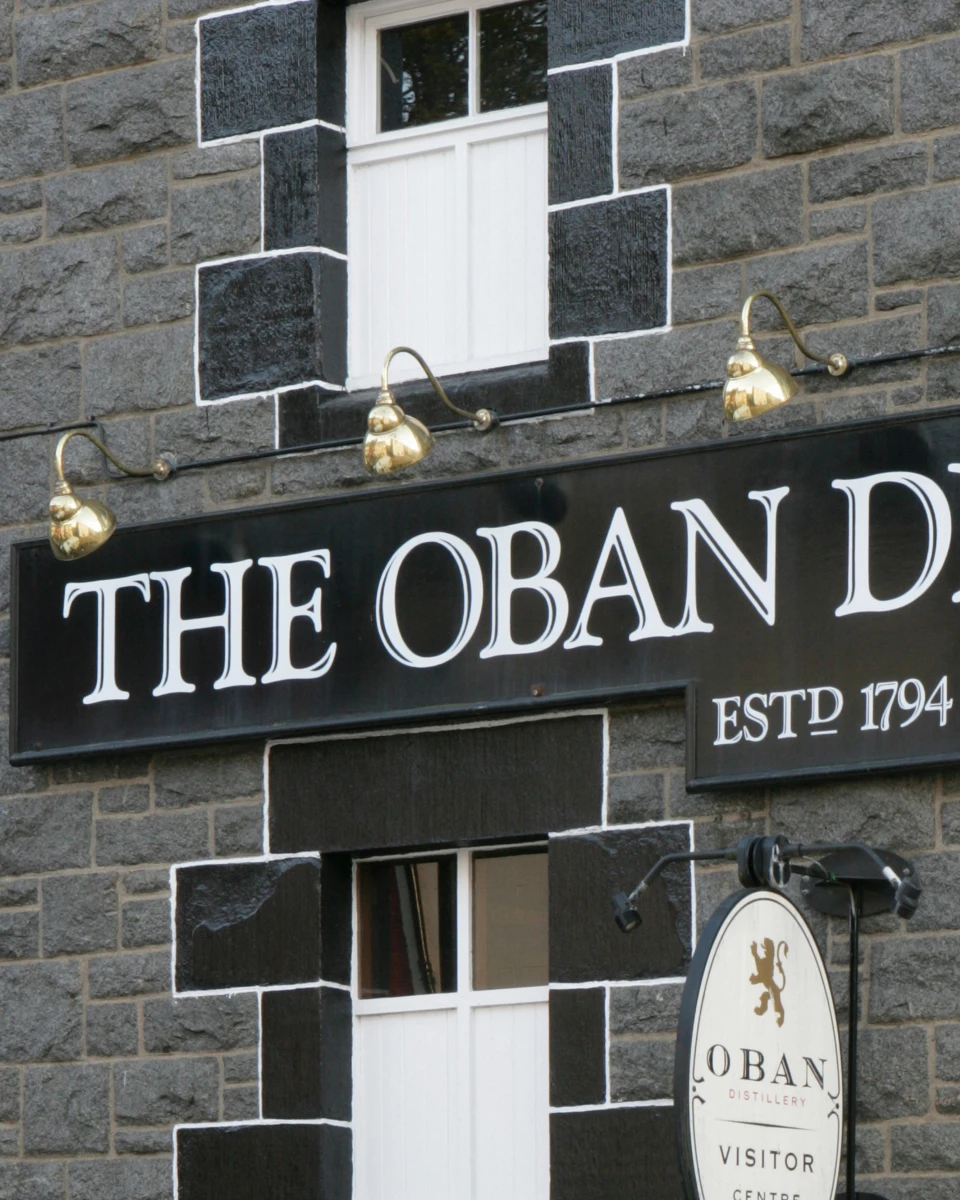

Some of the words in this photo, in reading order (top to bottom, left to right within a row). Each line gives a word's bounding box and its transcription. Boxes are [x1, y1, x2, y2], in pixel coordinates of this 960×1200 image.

[63, 548, 337, 706] THE
[375, 486, 790, 668] OBAN
[712, 686, 844, 746] ESTD
[860, 675, 953, 731] 1794
[706, 1043, 828, 1090] OBAN
[729, 1088, 806, 1107] DISTILLERY
[719, 1144, 815, 1173] VISITOR
